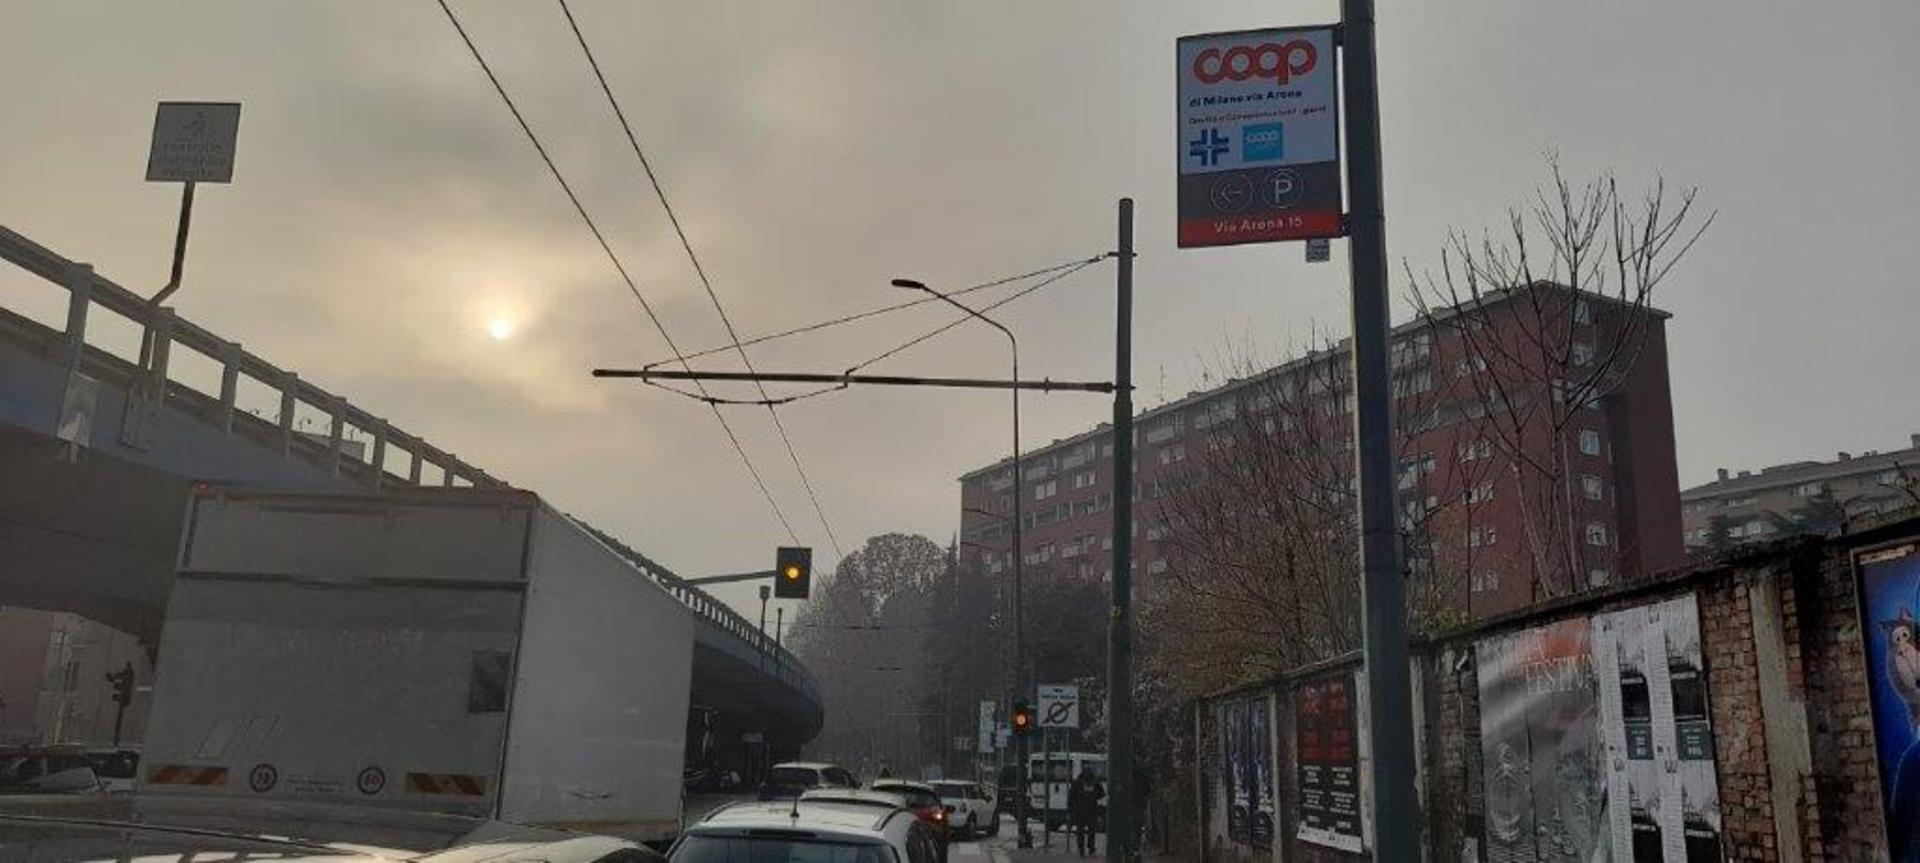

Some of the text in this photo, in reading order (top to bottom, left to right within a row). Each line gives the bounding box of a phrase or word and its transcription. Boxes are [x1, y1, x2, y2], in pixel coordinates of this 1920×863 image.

[1194, 39, 1317, 85] coop
[1189, 97, 1201, 107] di
[1203, 94, 1243, 106] Milano
[1245, 93, 1263, 103] via
[1214, 216, 1303, 233] Via Arona 15
